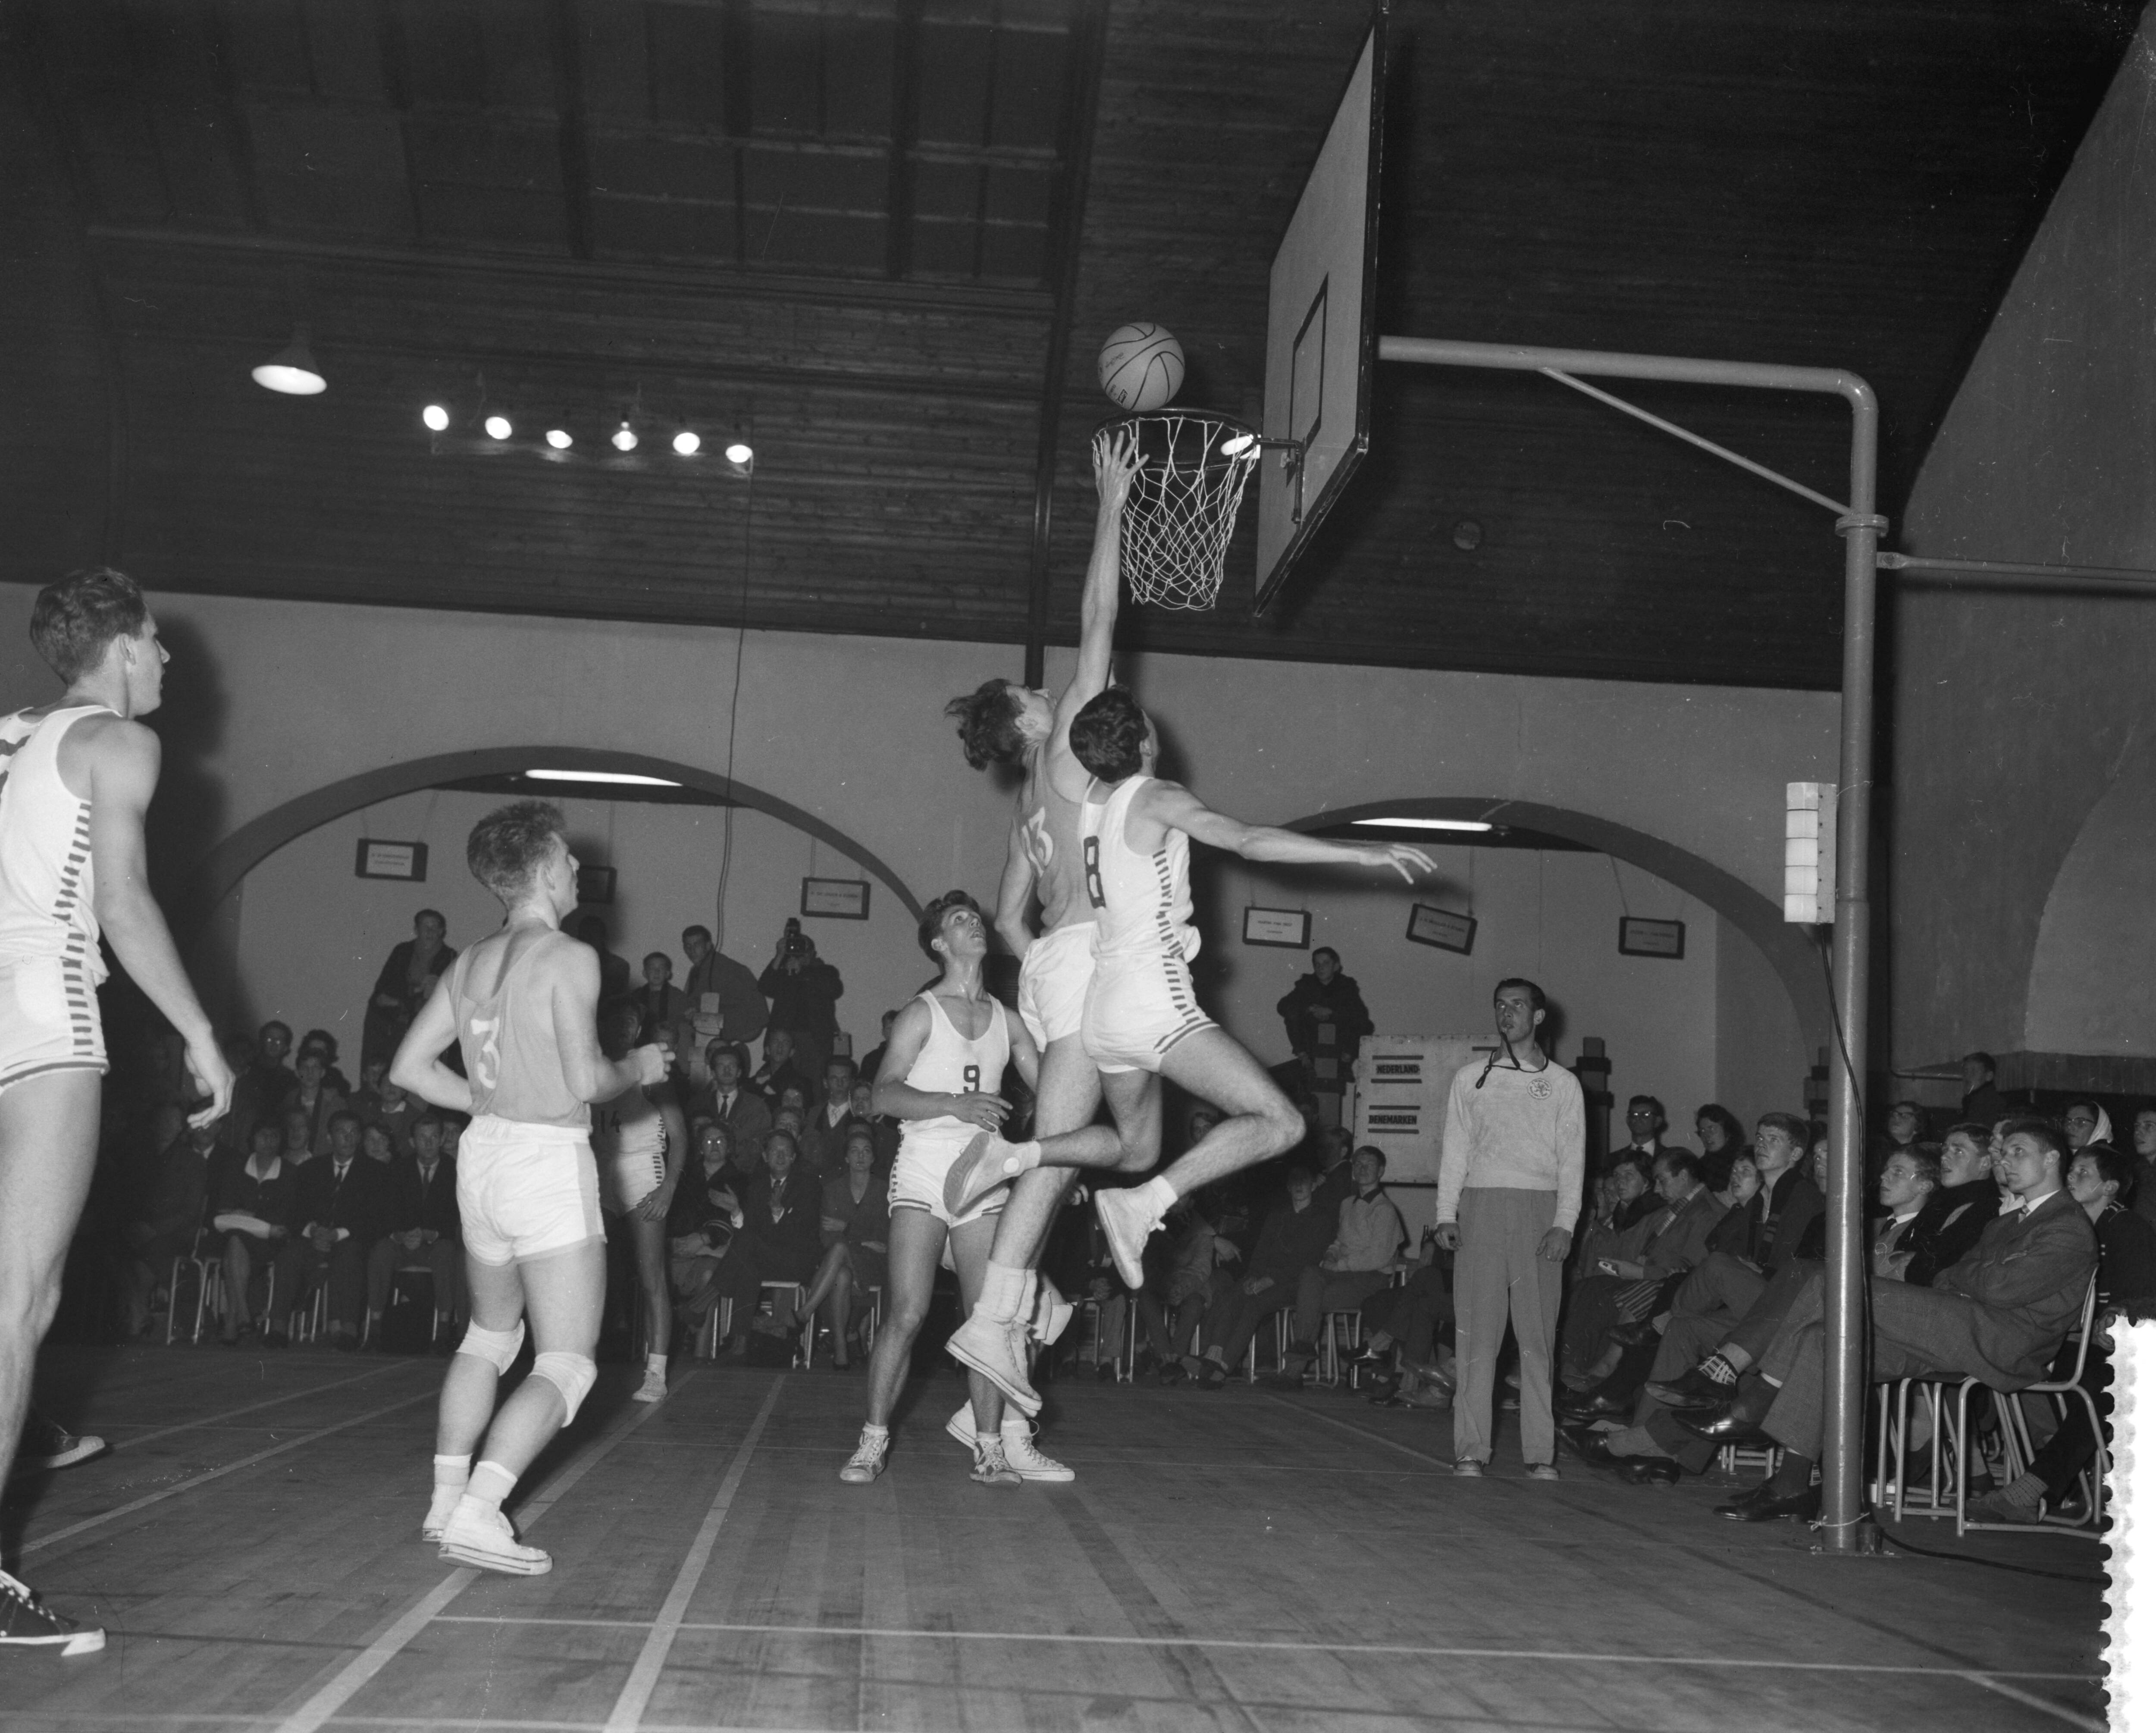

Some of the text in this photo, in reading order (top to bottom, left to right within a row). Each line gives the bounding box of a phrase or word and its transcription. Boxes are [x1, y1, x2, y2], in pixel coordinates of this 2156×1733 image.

[1084, 835, 1106, 909] 8
[471, 1017, 500, 1090] 3
[963, 1065, 980, 1093] 9
[601, 1110, 621, 1133] 14
[1369, 1115, 1417, 1125] DENEMARKEN
